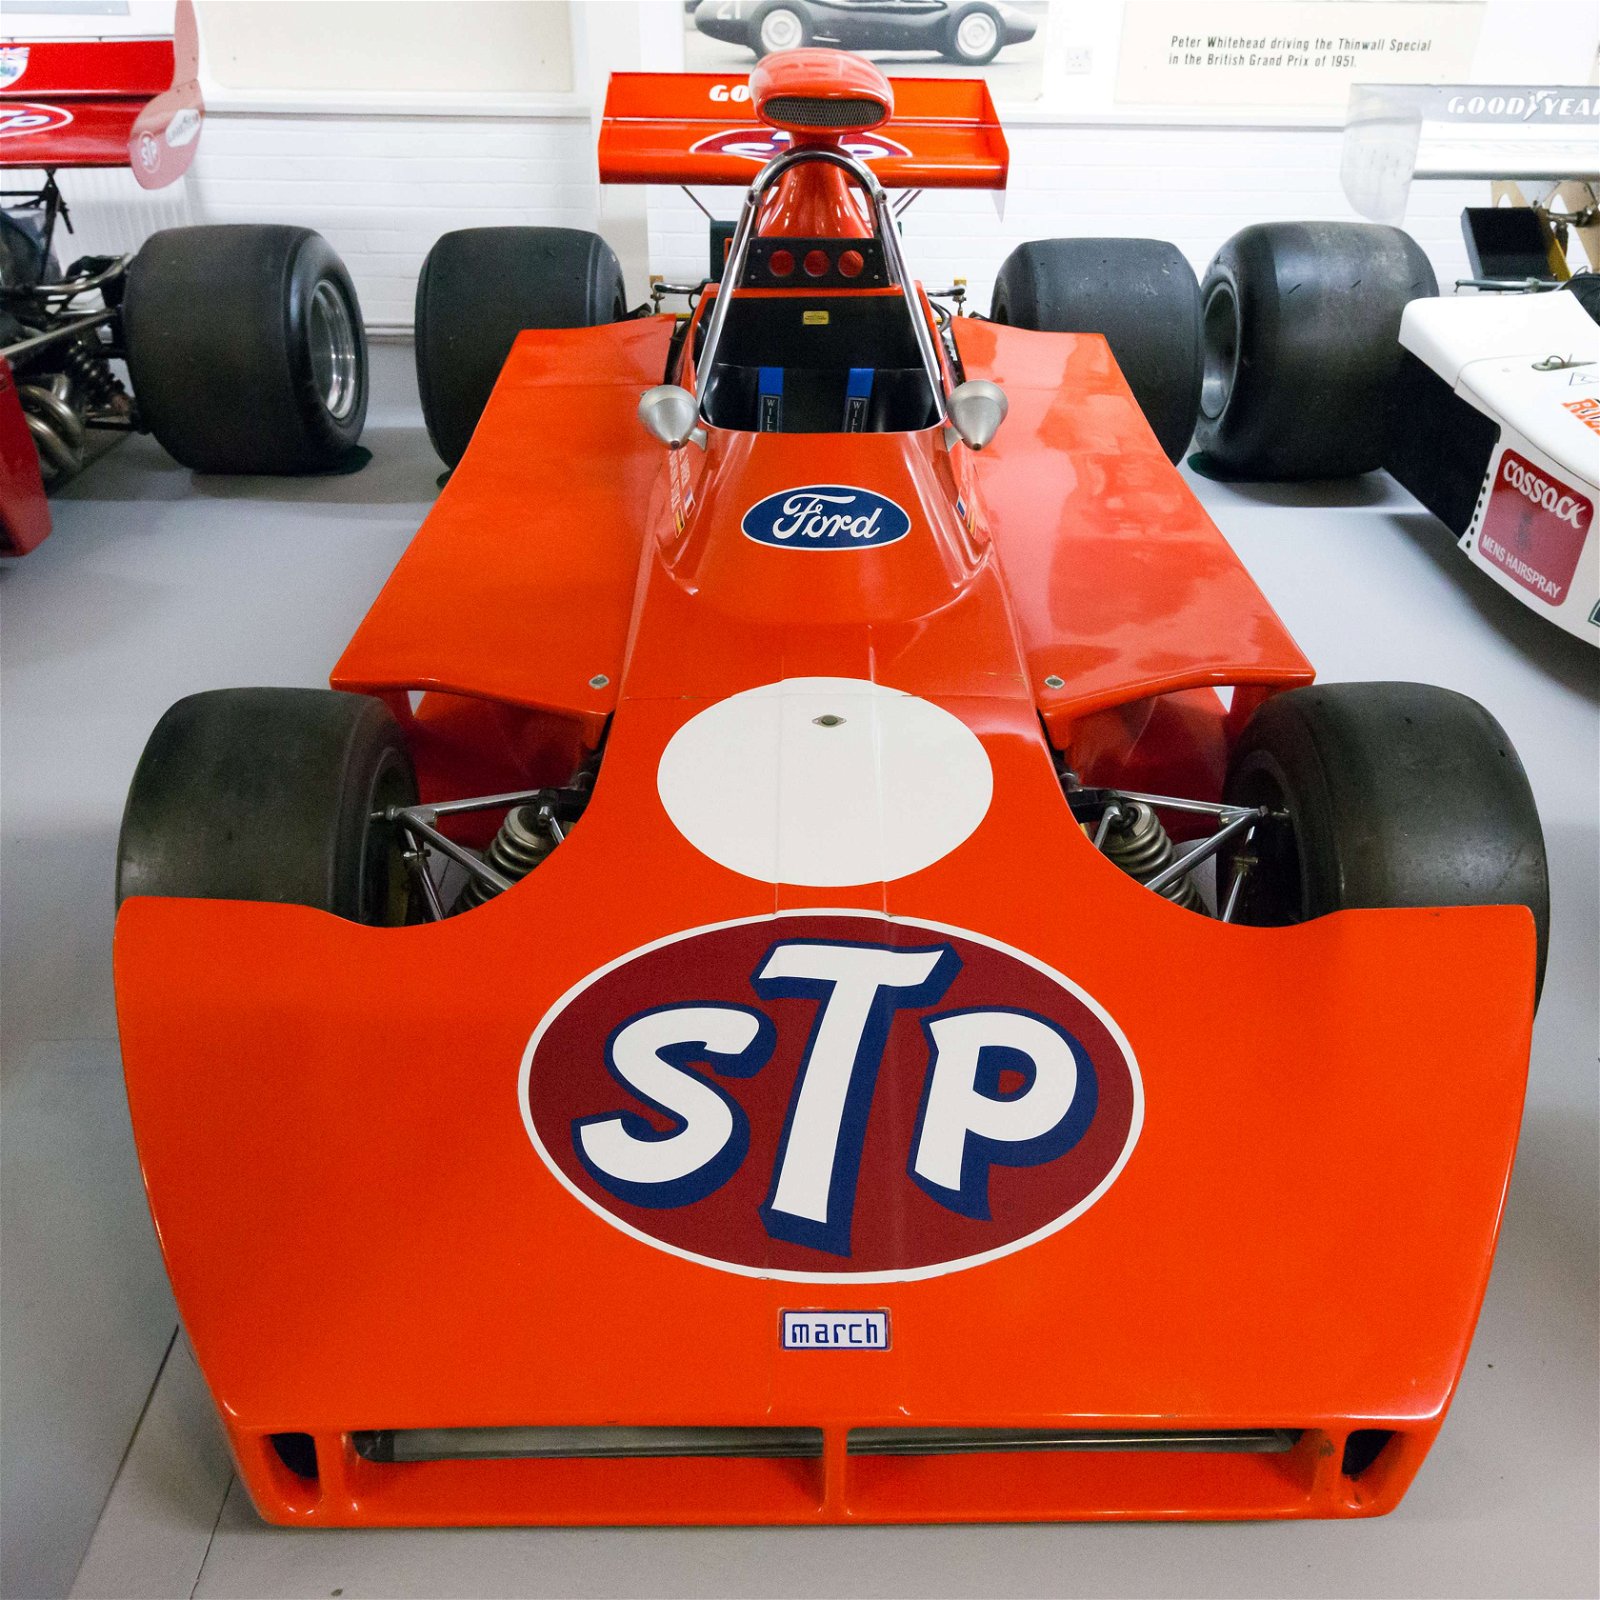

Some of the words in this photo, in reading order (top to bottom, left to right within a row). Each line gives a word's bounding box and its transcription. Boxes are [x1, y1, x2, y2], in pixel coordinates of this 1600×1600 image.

[1169, 53, 1179, 65] in
[1184, 53, 1202, 65] the
[1207, 53, 1245, 66] British
[1249, 53, 1283, 66] Grand
[1287, 54, 1309, 67] Prix
[1314, 55, 1326, 67] of
[1331, 55, 1357, 67] 1951.
[1171, 35, 1201, 48] Peter
[1207, 36, 1266, 49] Whitehead
[1270, 37, 1310, 52] driving
[1315, 38, 1333, 50] the
[1338, 38, 1386, 51] Thinwall
[1389, 39, 1432, 53] Special
[772, 493, 882, 539] Ford
[1482, 534, 1506, 562] MENS
[1506, 554, 1562, 599] HAIRSPRAY
[573, 940, 1096, 1254] STP
[791, 1317, 878, 1344] march
